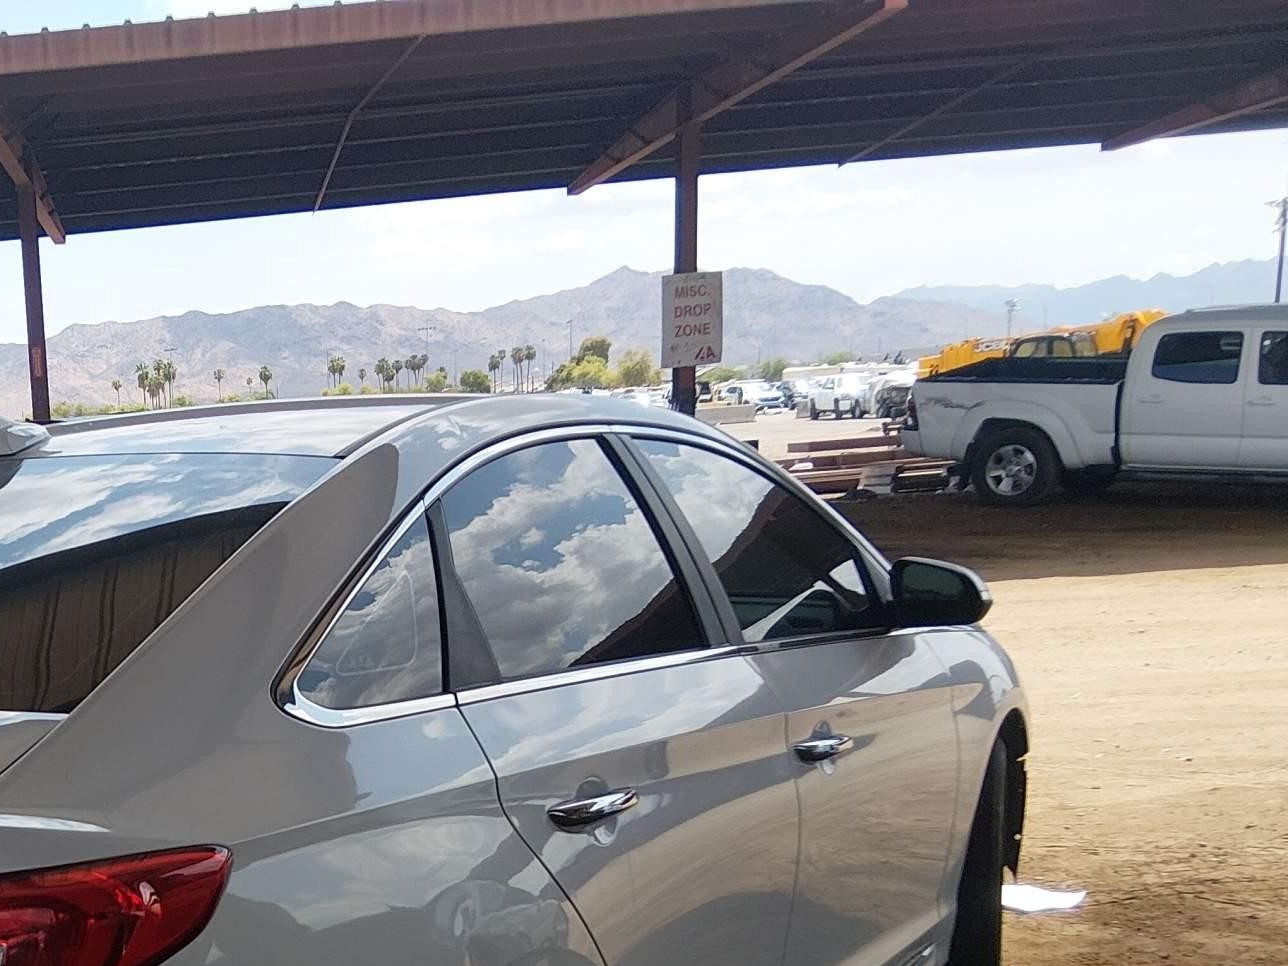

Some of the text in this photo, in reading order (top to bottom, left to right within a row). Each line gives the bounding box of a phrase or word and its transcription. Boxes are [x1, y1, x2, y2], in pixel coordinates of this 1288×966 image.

[674, 284, 711, 299] MISC.
[673, 303, 712, 319] DROP
[673, 322, 711, 338] ZONE
